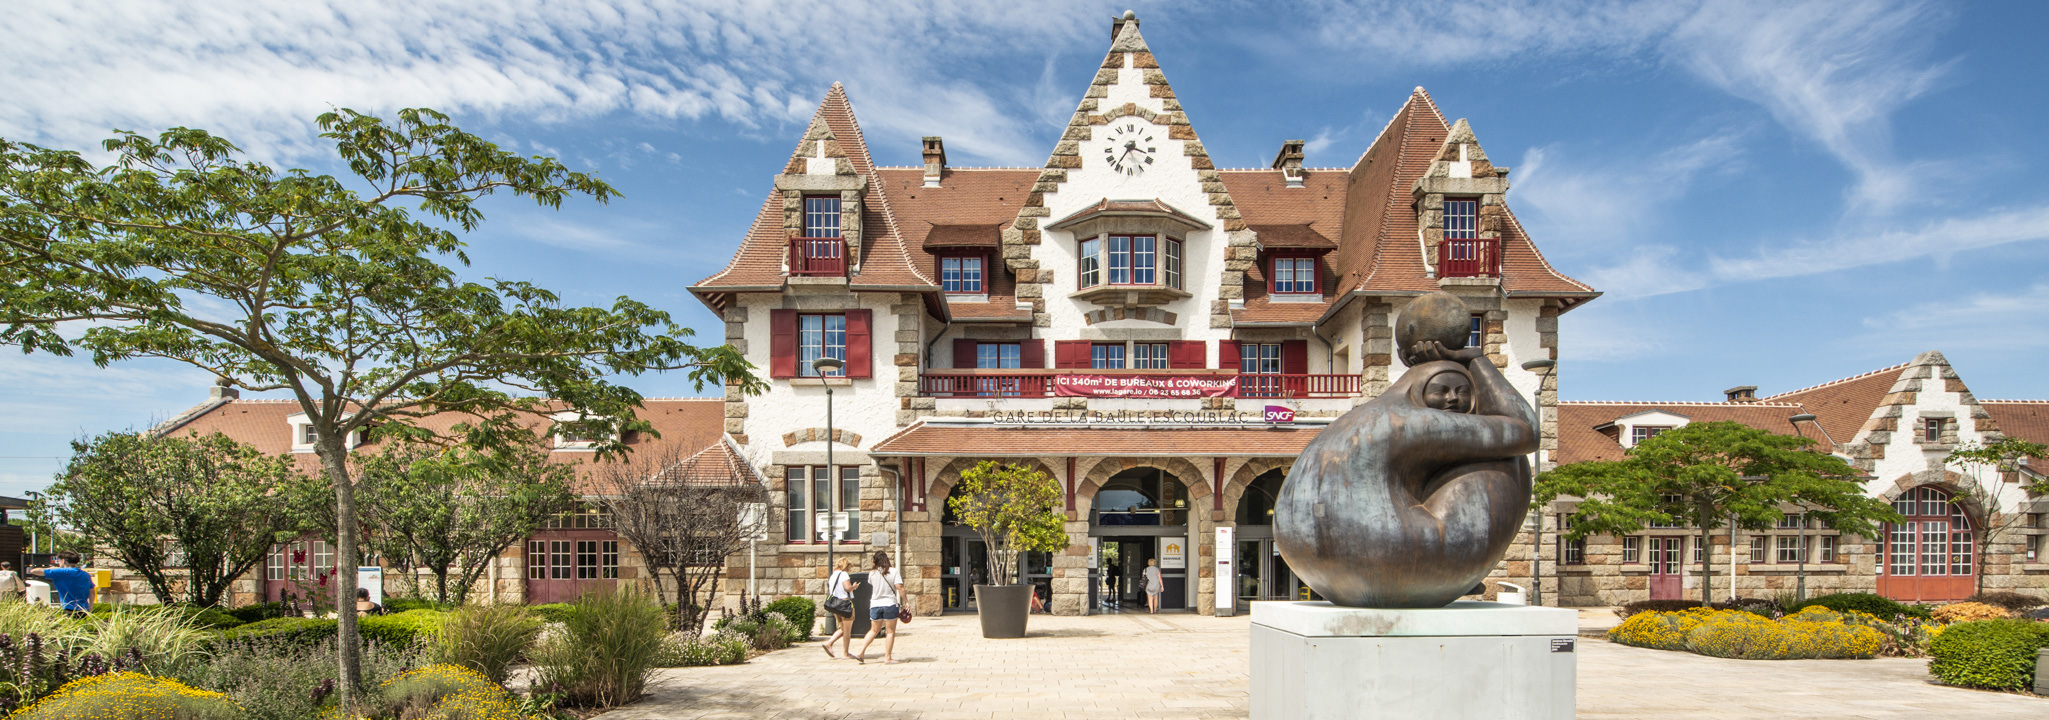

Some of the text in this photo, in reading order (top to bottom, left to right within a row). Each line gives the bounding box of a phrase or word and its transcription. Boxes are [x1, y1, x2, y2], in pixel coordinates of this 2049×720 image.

[1057, 377, 1069, 385] ICI
[1105, 378, 1118, 386] DE
[1120, 378, 1165, 388] BUREAUX
[1167, 380, 1174, 388] &
[1176, 379, 1236, 388] COWORKING
[994, 411, 1034, 423] GARE
[1042, 412, 1062, 423] DE
[1070, 411, 1088, 423] LA
[1266, 412, 1294, 420] SNCF
